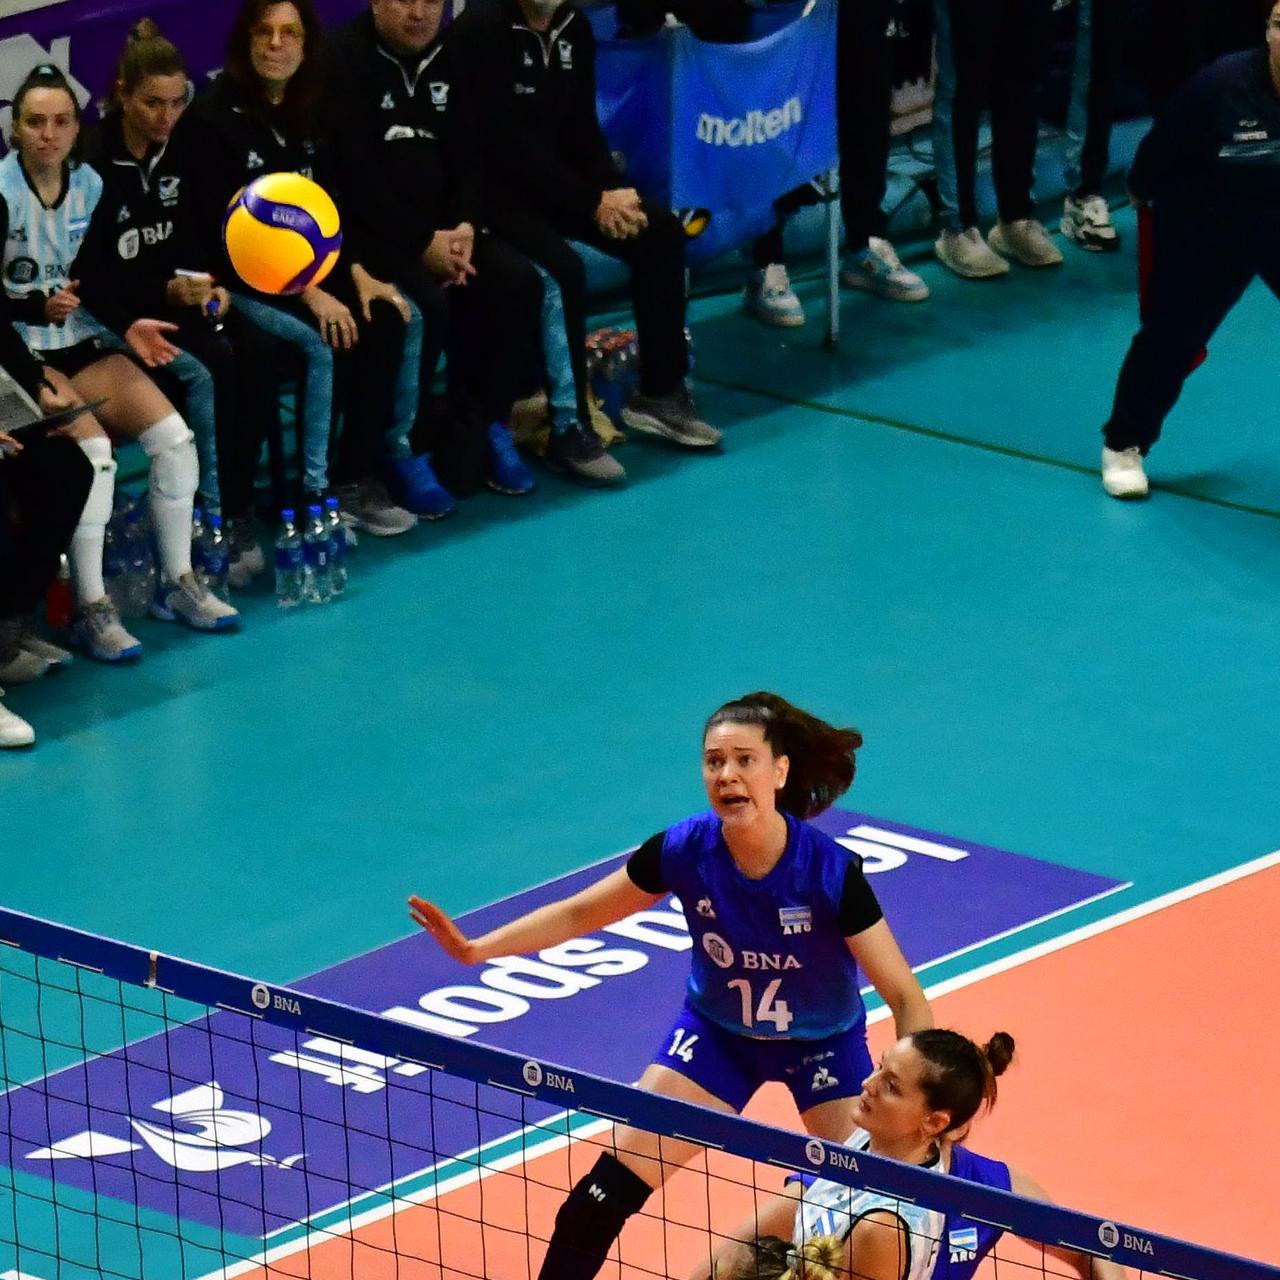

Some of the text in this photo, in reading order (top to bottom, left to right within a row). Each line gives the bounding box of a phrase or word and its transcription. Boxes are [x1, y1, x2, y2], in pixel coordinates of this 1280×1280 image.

[697, 96, 801, 147] molten
[741, 950, 803, 970] BNA
[274, 995, 301, 1014] BNA
[727, 978, 793, 1032] 14
[667, 1028, 700, 1063] 14
[547, 1073, 574, 1092] BNA
[830, 1152, 859, 1172] BNA
[1124, 1234, 1154, 1255] BNA
